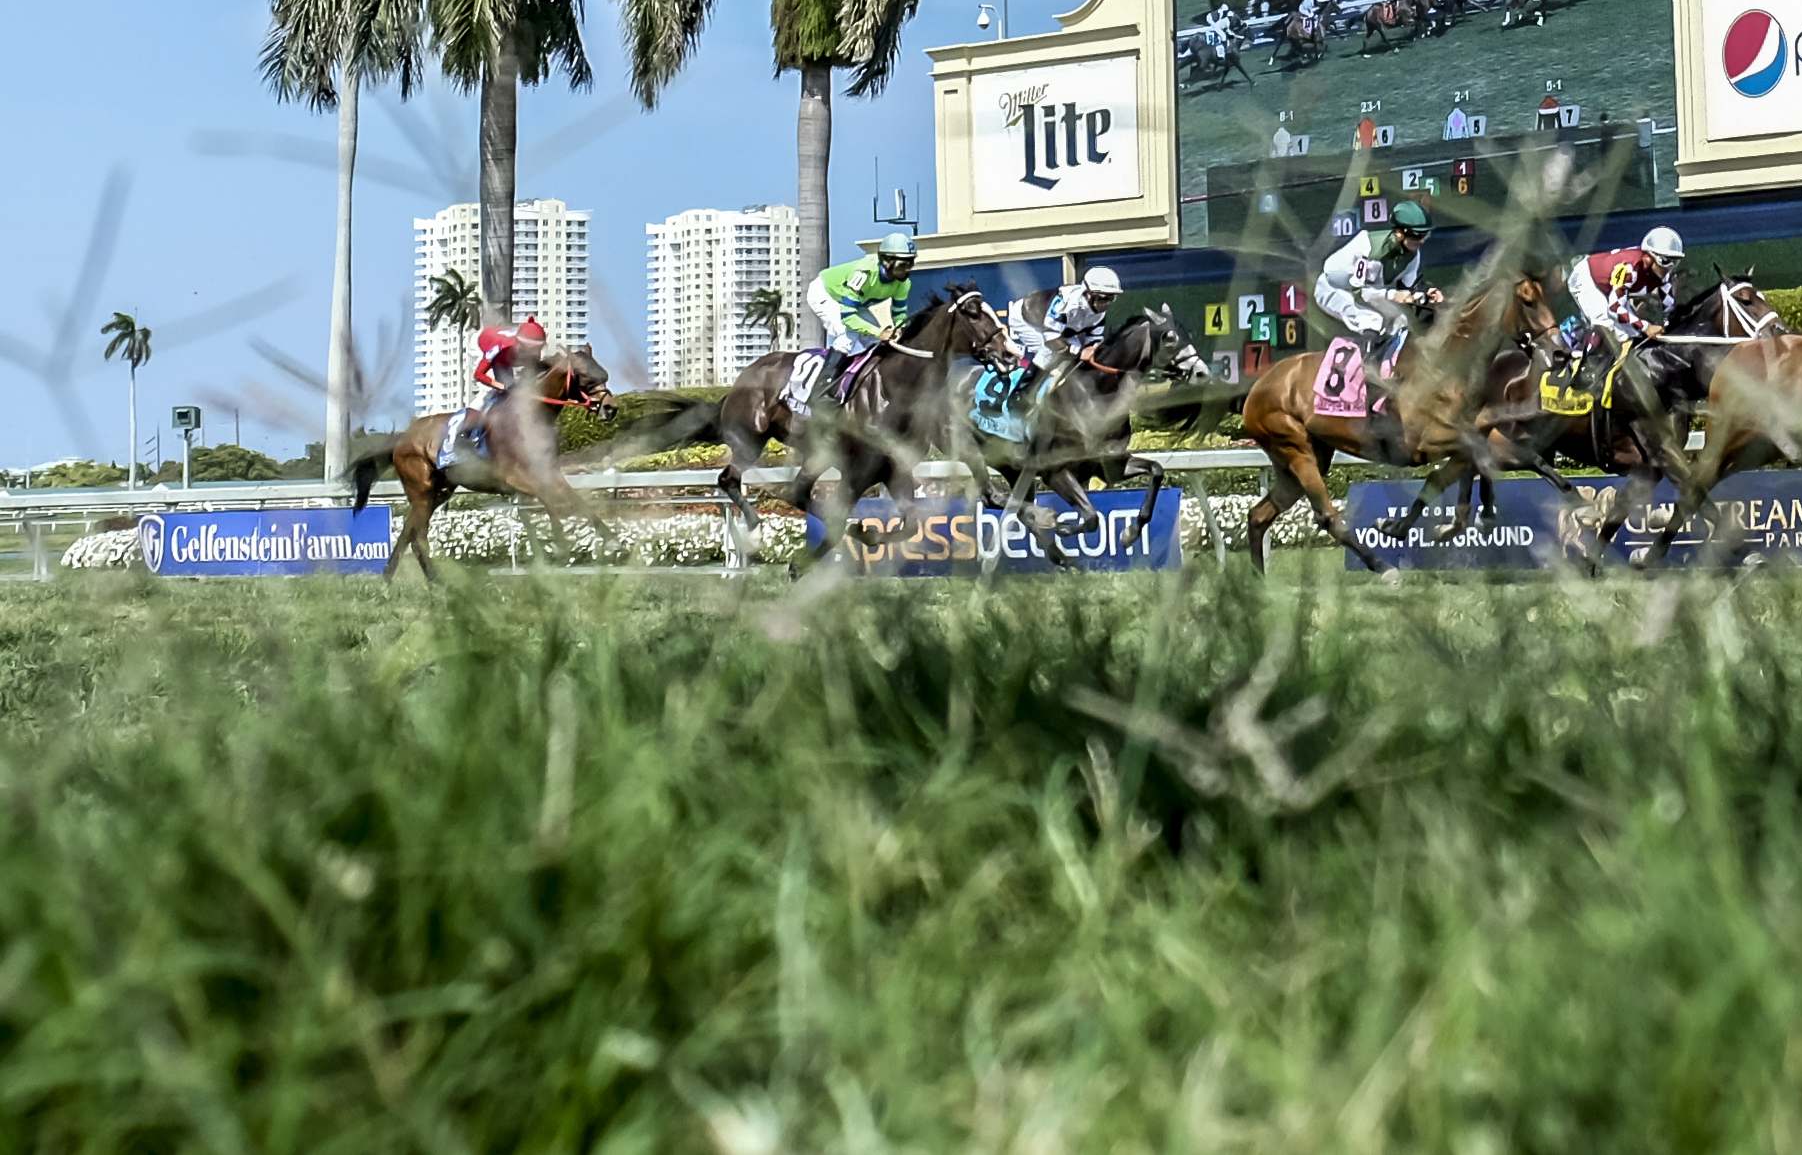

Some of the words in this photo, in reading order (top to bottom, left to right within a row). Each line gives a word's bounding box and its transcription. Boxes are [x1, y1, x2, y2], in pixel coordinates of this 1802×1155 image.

[998, 83, 1050, 125] Miller
[1566, 109, 1573, 124] 7
[1018, 102, 1112, 191] Lite
[1297, 138, 1303, 153] 1
[1381, 129, 1389, 144] 6
[1459, 161, 1466, 175] 1
[1365, 178, 1375, 194] 4
[1408, 172, 1418, 188] 2
[1458, 177, 1468, 194] 6
[1371, 201, 1381, 220] 8
[1333, 217, 1354, 236] 10
[1356, 260, 1365, 279] 8
[1615, 265, 1625, 285] 4
[1286, 285, 1295, 311] 1
[1211, 305, 1223, 331] 4
[1246, 299, 1257, 325] 2
[1259, 316, 1270, 341] 5
[1285, 318, 1297, 345] 6
[1252, 345, 1264, 372] 7
[1324, 346, 1358, 398] 8
[978, 372, 1012, 418] 9
[1387, 506, 1456, 518] WECOM
[171, 522, 389, 563] GelfensteinFarm.com
[843, 500, 1150, 574] pressbecom
[1408, 525, 1534, 548] PLGROUND
